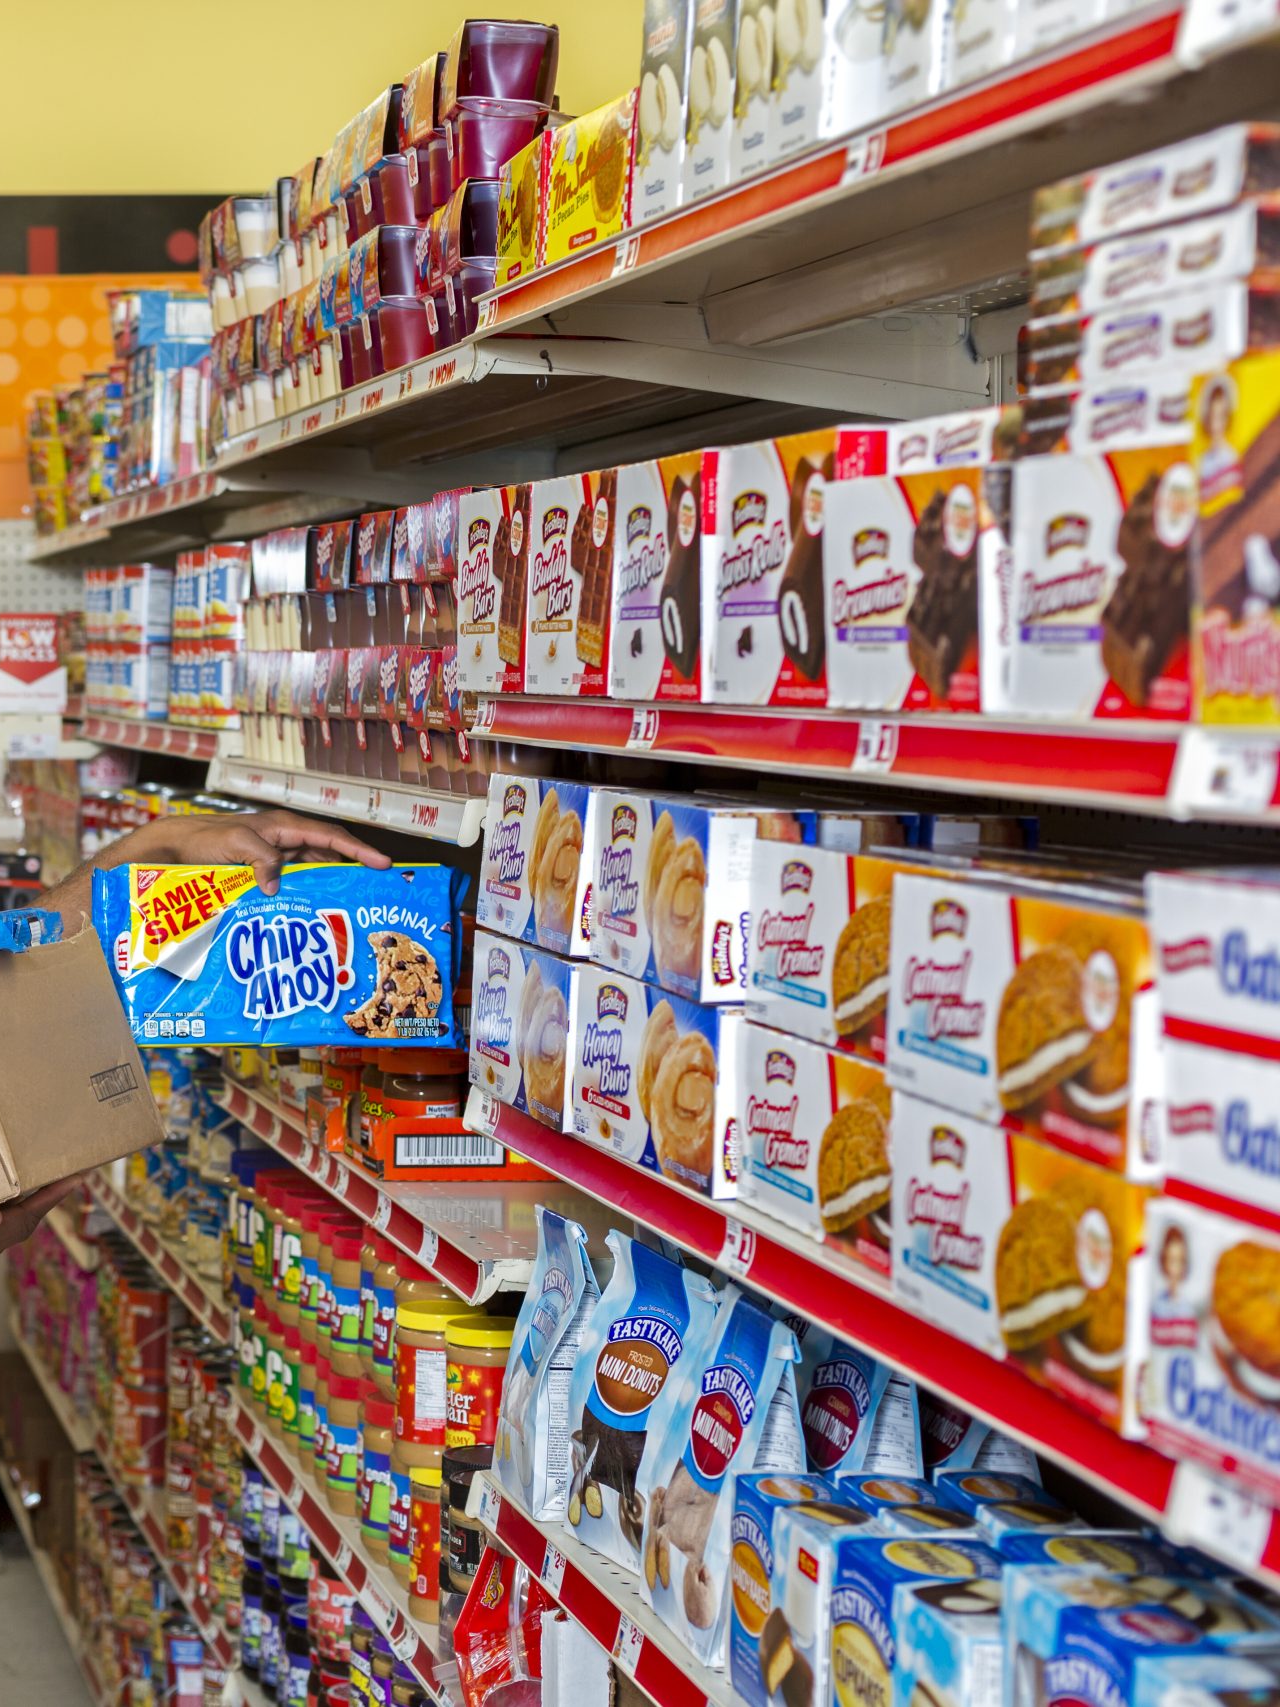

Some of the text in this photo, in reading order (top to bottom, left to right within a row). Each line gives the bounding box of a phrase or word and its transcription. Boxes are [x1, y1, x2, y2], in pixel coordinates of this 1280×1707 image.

[557, 205, 575, 226] Pecan
[575, 190, 590, 210] Pies
[435, 358, 456, 381] WOW!
[366, 387, 383, 408] WOW!
[470, 526, 490, 548] Freshley's
[543, 515, 567, 540] Freshley's
[640, 532, 666, 588] Rolls
[752, 519, 787, 580] Rolls
[461, 549, 490, 600] Buddy
[532, 540, 567, 596] Buddy
[473, 585, 495, 622] Bars
[546, 579, 572, 620] Bars
[832, 567, 908, 628] Brownies
[1021, 561, 1105, 624] Brownies
[0, 629, 56, 646] LOW
[0, 647, 57, 662] PRICES
[380, 650, 398, 678] Snack
[410, 655, 430, 684] Snack
[381, 669, 396, 700] Pack
[410, 675, 427, 709] Pack
[417, 804, 438, 828] WOW!
[504, 794, 525, 816] Freshley's
[489, 822, 520, 860] Honey
[612, 812, 636, 840] Freshley's
[219, 870, 250, 887] TAMAÑO
[499, 849, 525, 883] Buns
[599, 847, 633, 888] Honey
[139, 870, 218, 923] FAMILY
[222, 874, 254, 895] FAMILIAR
[610, 882, 638, 917] Buns
[144, 889, 228, 945] SIZE!
[235, 901, 312, 919] Real Chocolate Chip Cookies
[356, 907, 437, 940] ORIGINAL
[758, 902, 814, 951] Oatmeal
[118, 939, 129, 971] LIFT
[228, 915, 329, 972] Chips
[719, 923, 733, 982] Freshley's
[245, 911, 354, 1016] Ahoy!
[488, 953, 510, 979] Freshley's
[777, 945, 823, 980] Cremes
[477, 982, 507, 1021] Honey
[598, 992, 628, 1020] Freshley's
[401, 1028, 408, 1036] LB
[408, 1028, 417, 1036] 2.2
[417, 1028, 423, 1036] OZ
[426, 1018, 440, 1027] NETO
[487, 1015, 513, 1047] Buns
[928, 1001, 986, 1041] Cremes
[582, 1023, 622, 1068] Honey
[587, 1087, 593, 1103] 6
[599, 1060, 631, 1096] Buns
[427, 1105, 455, 1113] Nutrition
[747, 1095, 798, 1136] Oatmeal
[764, 1132, 810, 1170] Cremes
[544, 1269, 574, 1311] TASTYKAKE
[613, 1317, 683, 1363] TASTYKAKE
[598, 1353, 663, 1397] MINI DONUTS
[628, 1350, 653, 1368] FROSTED
[446, 1391, 474, 1410] eter
[703, 1368, 755, 1426] TASTYKAKE
[817, 1361, 869, 1417] TASTYKAKE
[446, 1410, 469, 1425] an
[693, 1408, 736, 1460] MINI DONUTS
[805, 1403, 853, 1452] MINI DONUTS
